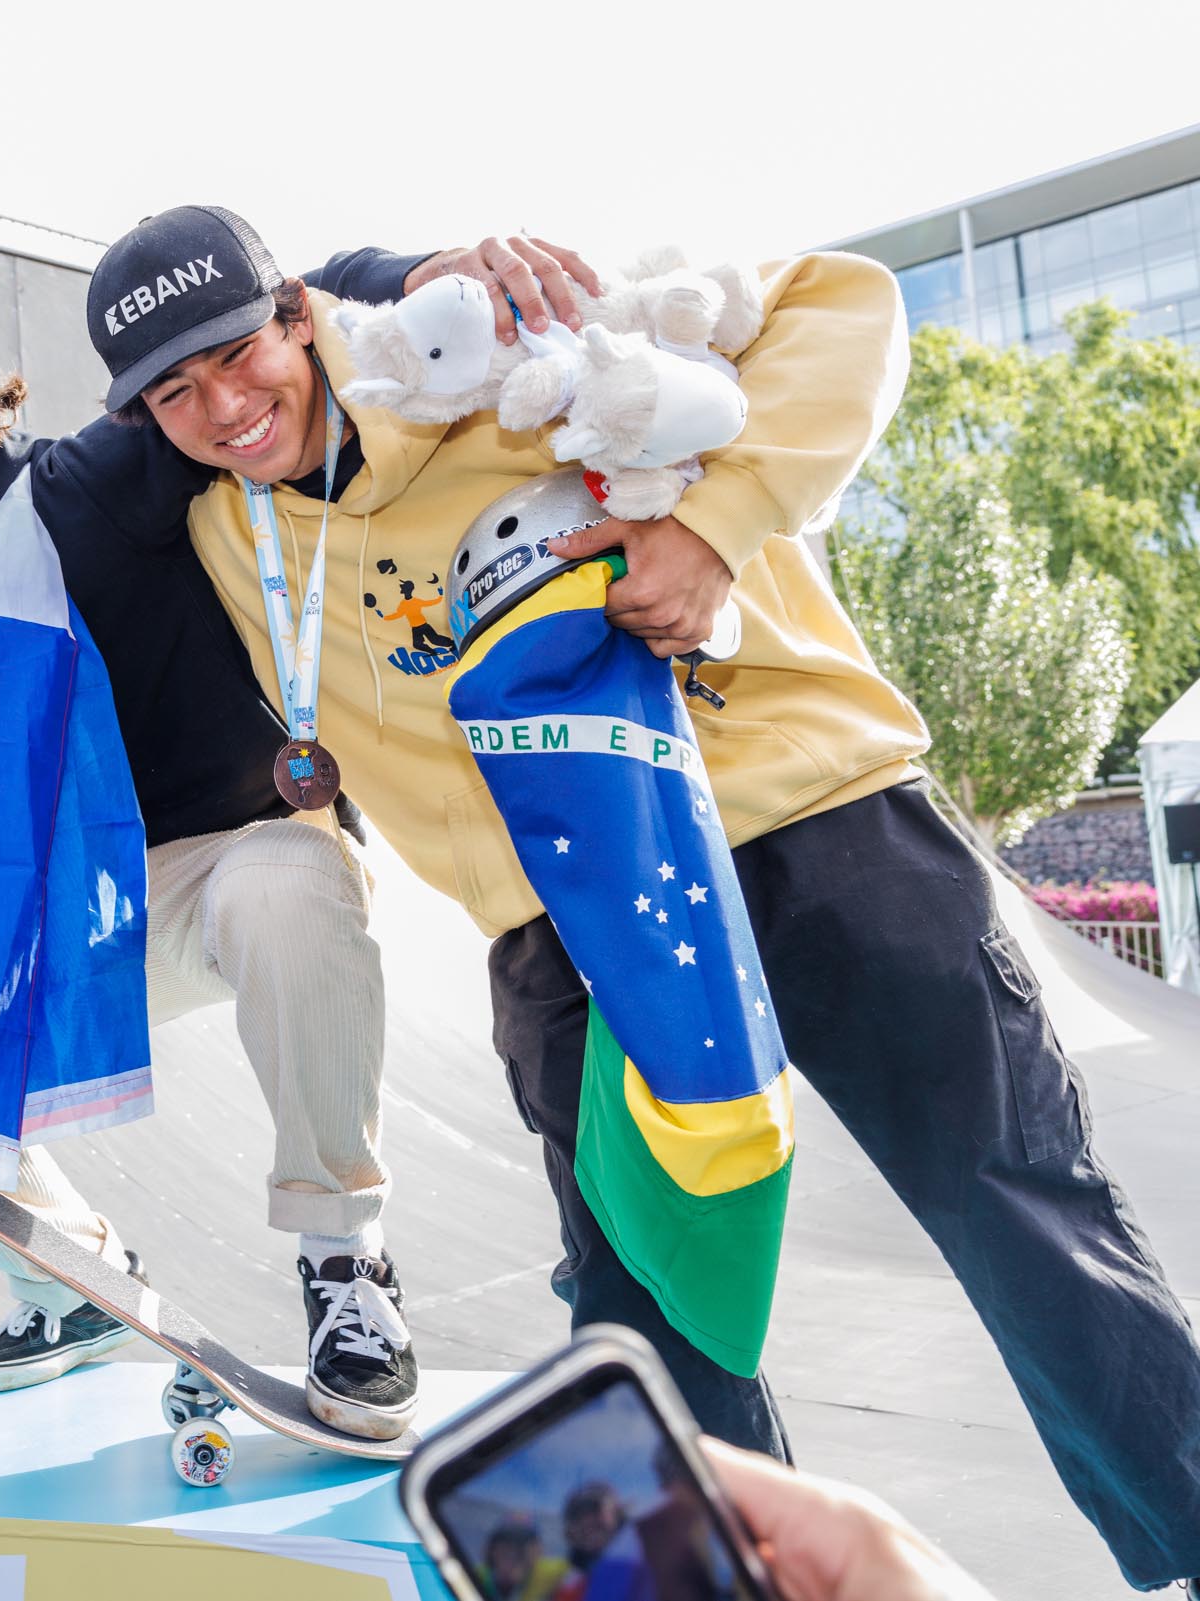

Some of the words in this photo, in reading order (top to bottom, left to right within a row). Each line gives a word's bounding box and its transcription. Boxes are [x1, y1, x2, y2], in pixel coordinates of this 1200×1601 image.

[119, 254, 224, 325] EBANX
[469, 552, 522, 605] Pro-tec
[609, 725, 627, 751] E
